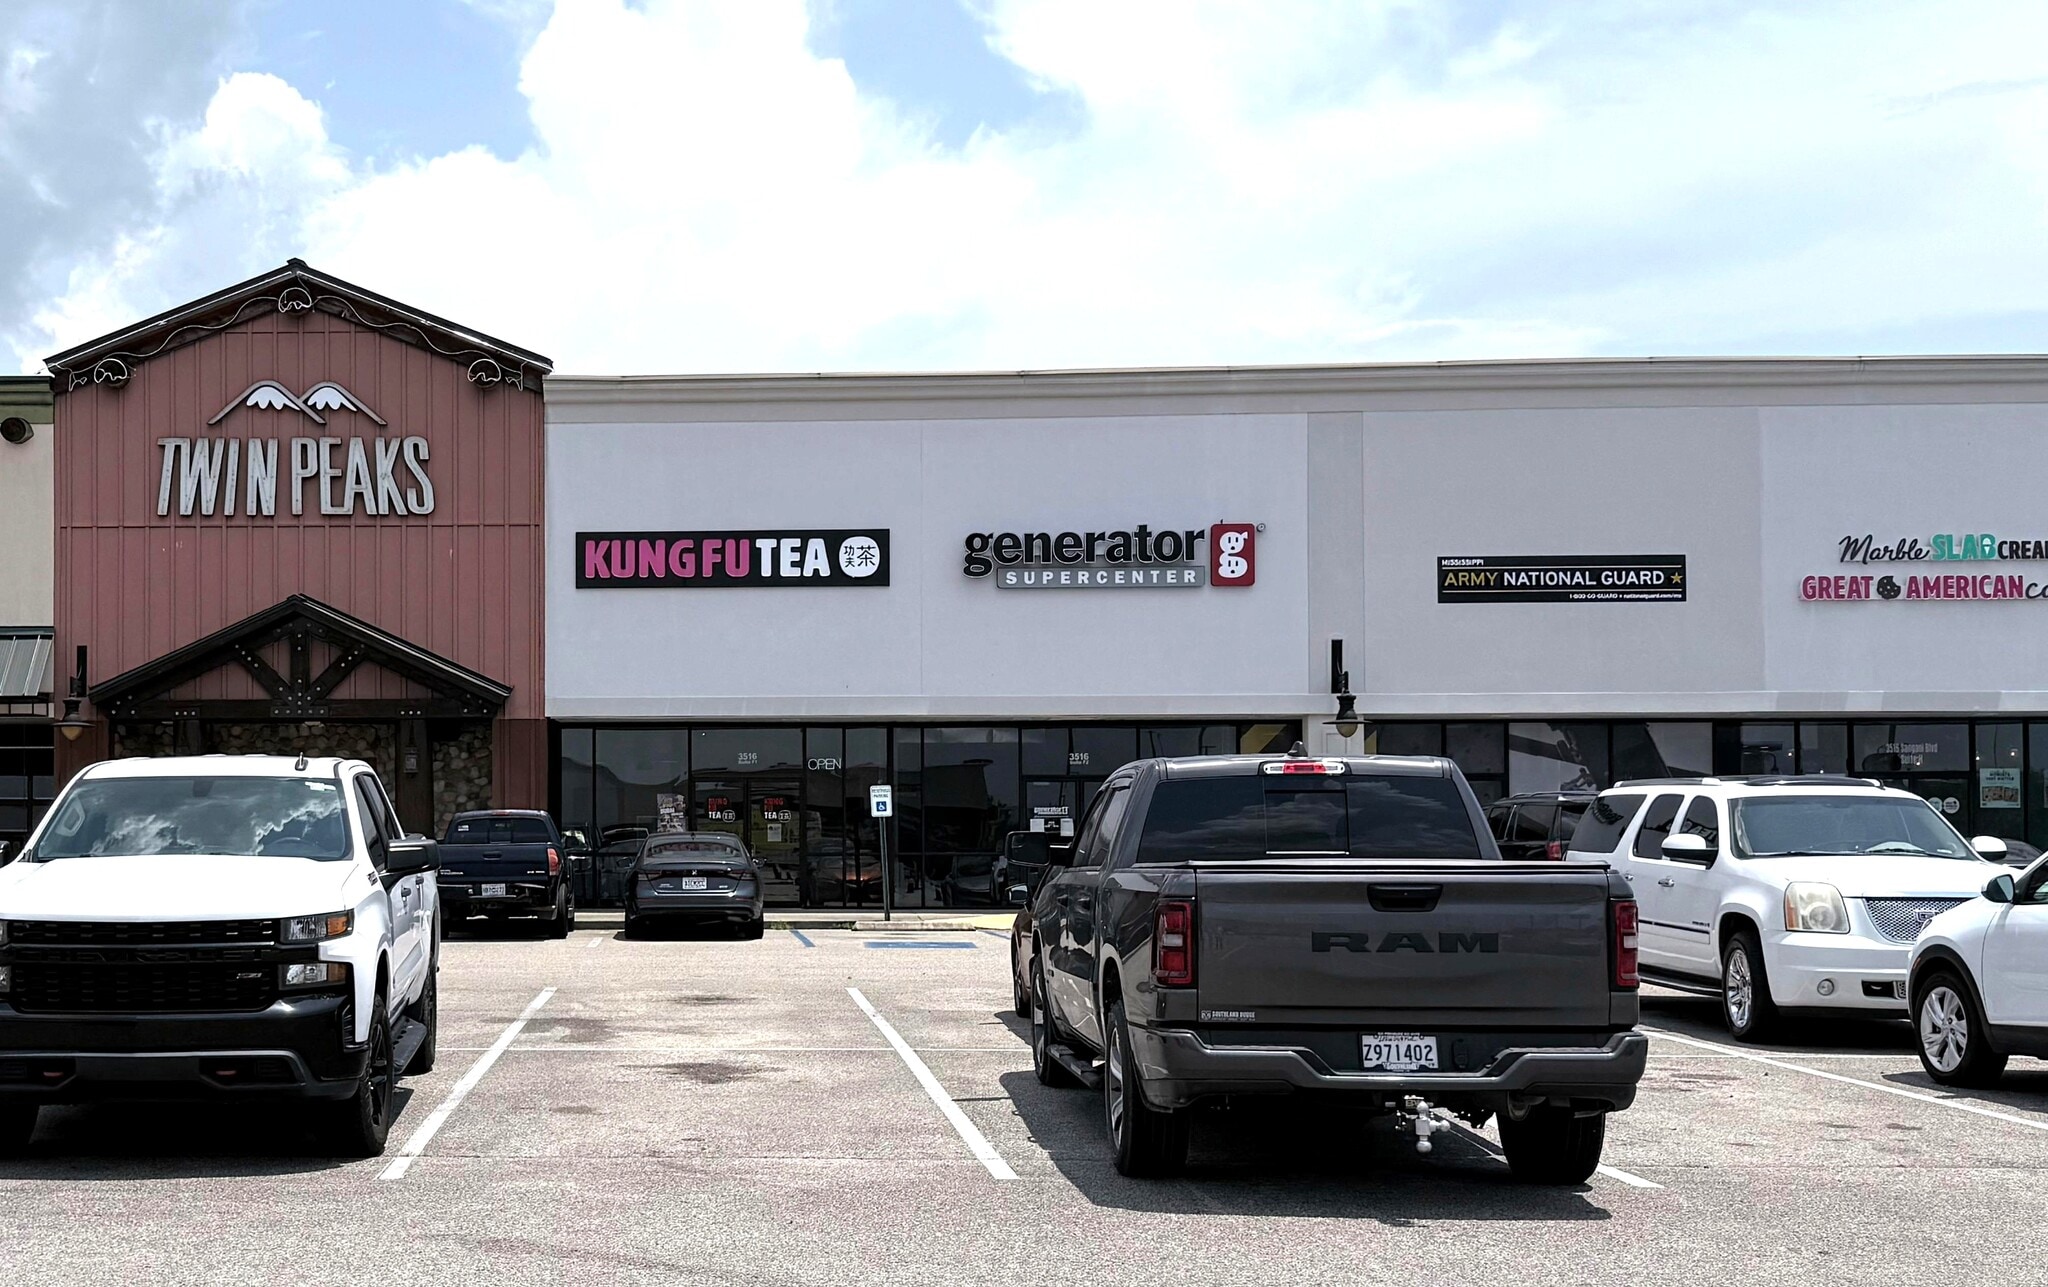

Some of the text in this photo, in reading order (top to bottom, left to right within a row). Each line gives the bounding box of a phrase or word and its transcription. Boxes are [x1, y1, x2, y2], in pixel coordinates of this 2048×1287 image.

[157, 435, 435, 516] TWIN PEAKS
[584, 536, 831, 578] KUNG FU TEA
[963, 524, 1205, 578] generator
[1838, 534, 1931, 565] Marble
[1930, 533, 1996, 561] SLAB
[1441, 559, 1484, 567] MISSISSIPPI
[1005, 570, 1197, 584] SUPERCENTER
[1444, 570, 1665, 586] ARMY NATIONAL GUARD
[1801, 575, 1874, 600] GREAT
[1905, 574, 2024, 600] AMERICAN
[738, 752, 758, 760] 3516
[807, 758, 842, 770] OPEN
[1069, 752, 1090, 761] 3516
[708, 811, 722, 819] TEA
[763, 811, 777, 819] TEA
[1311, 931, 1500, 953] RAM
[1363, 1043, 1434, 1062] Z971402
